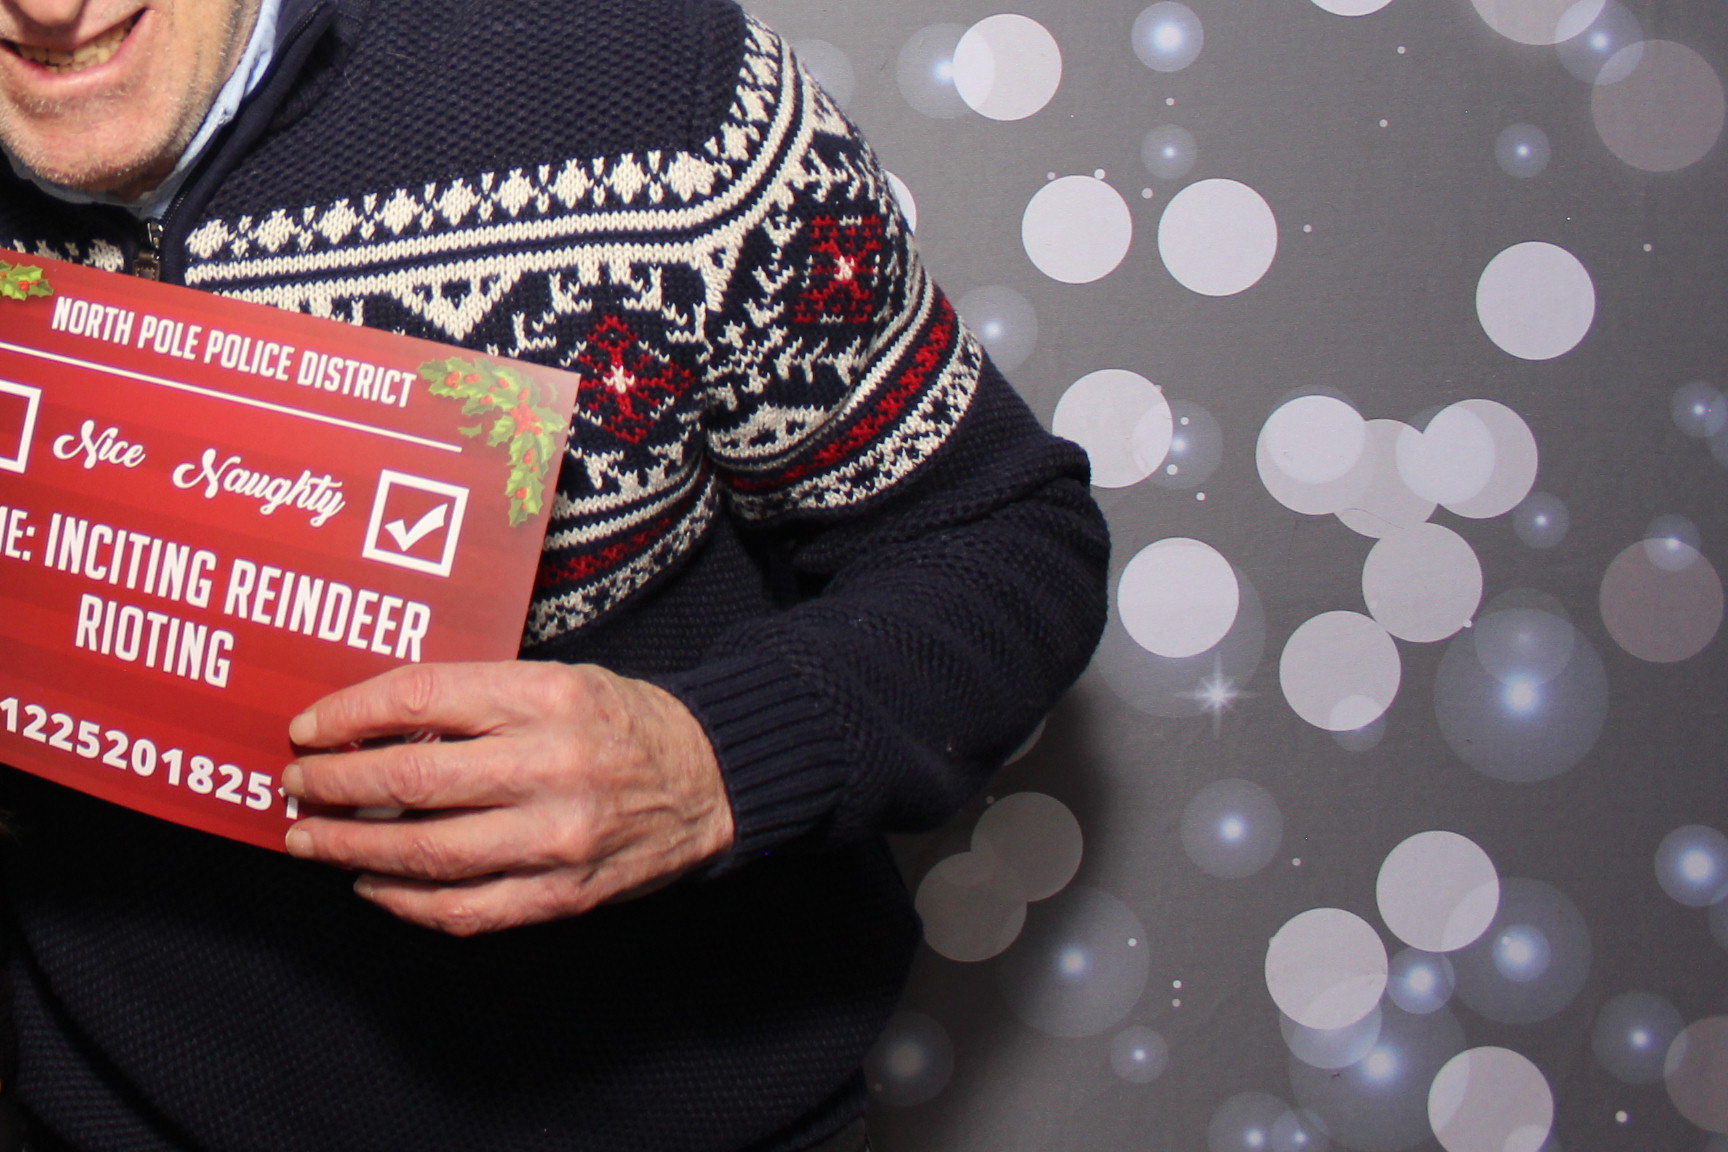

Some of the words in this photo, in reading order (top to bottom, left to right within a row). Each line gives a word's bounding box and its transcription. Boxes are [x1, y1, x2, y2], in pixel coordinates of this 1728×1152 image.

[52, 296, 134, 346] NORTH
[137, 315, 201, 361] POLE
[204, 329, 295, 381] POLICE
[297, 351, 418, 408] DISTRICT
[52, 419, 146, 470] Nice
[172, 449, 346, 527] Naughty
[44, 512, 217, 609] INCITING
[223, 558, 432, 665] REINDEER
[75, 593, 235, 688] RIOTING
